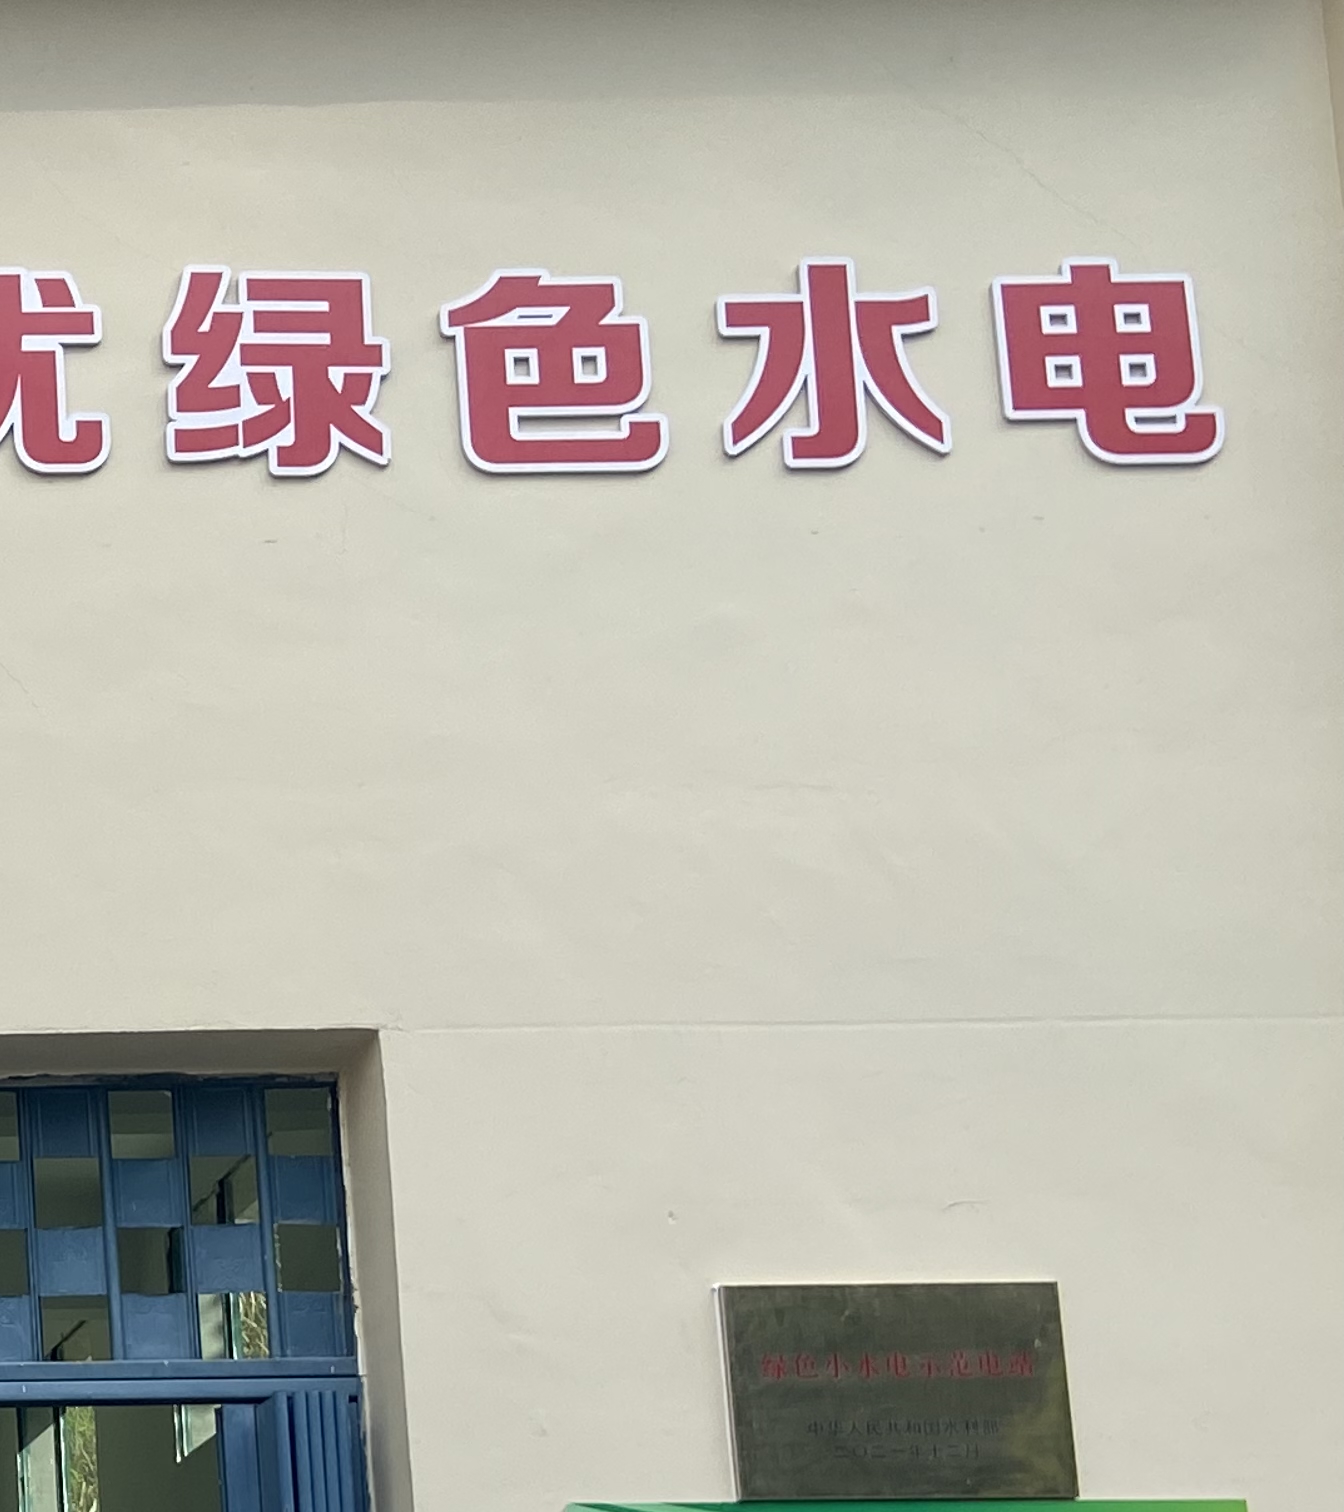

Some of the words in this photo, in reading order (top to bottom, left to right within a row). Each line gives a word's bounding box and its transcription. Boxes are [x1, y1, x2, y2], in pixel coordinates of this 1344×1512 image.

[762, 1352, 1035, 1379] 绿色小水电示范电站
